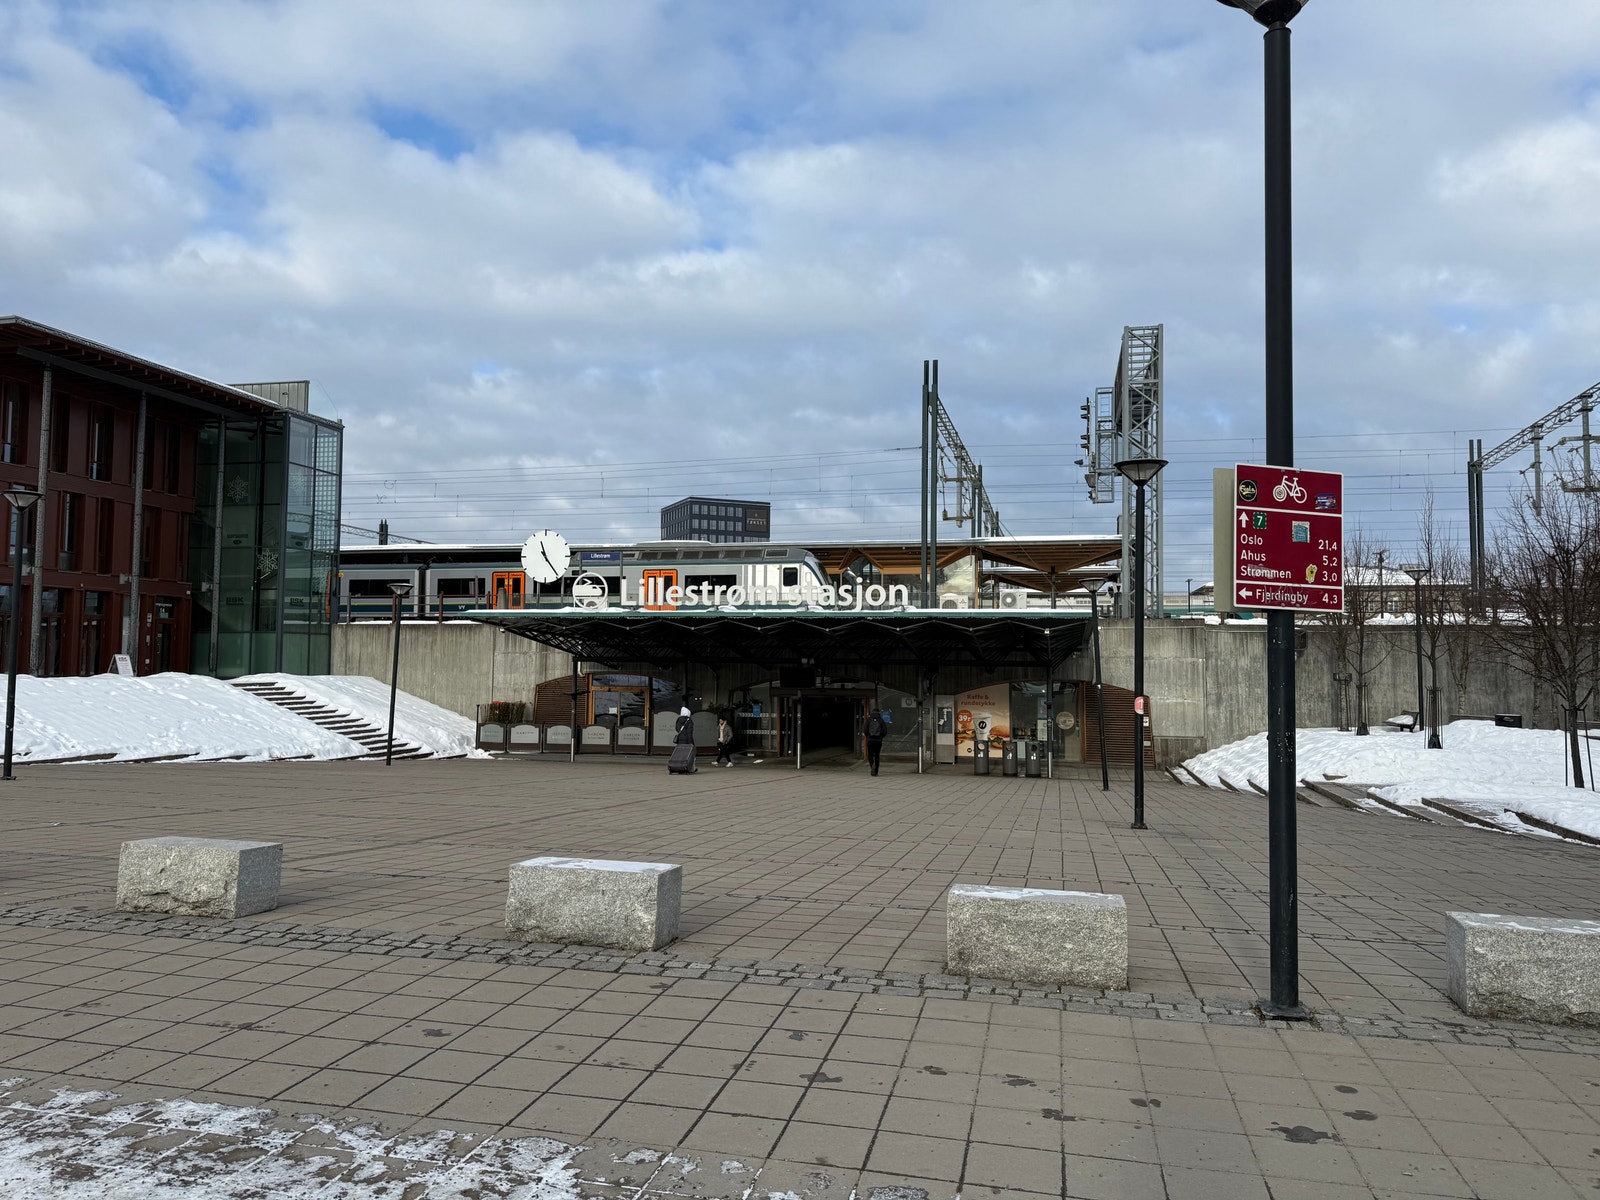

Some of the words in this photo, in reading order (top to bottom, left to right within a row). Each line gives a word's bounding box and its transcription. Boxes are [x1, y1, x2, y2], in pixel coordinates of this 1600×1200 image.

[1257, 515, 1263, 526] 7
[1240, 533, 1263, 546] Oslo
[1318, 539, 1338, 551] 21,4
[1240, 549, 1267, 562] Ahus
[1322, 555, 1338, 567] 5,2
[1240, 565, 1292, 579] Strømmen
[1322, 570, 1338, 582] 3,0
[620, 577, 778, 606] Lillestrøm
[787, 575, 909, 611] stasjon
[1256, 588, 1309, 604] Fjerdingby
[1322, 593, 1338, 604] 4,3
